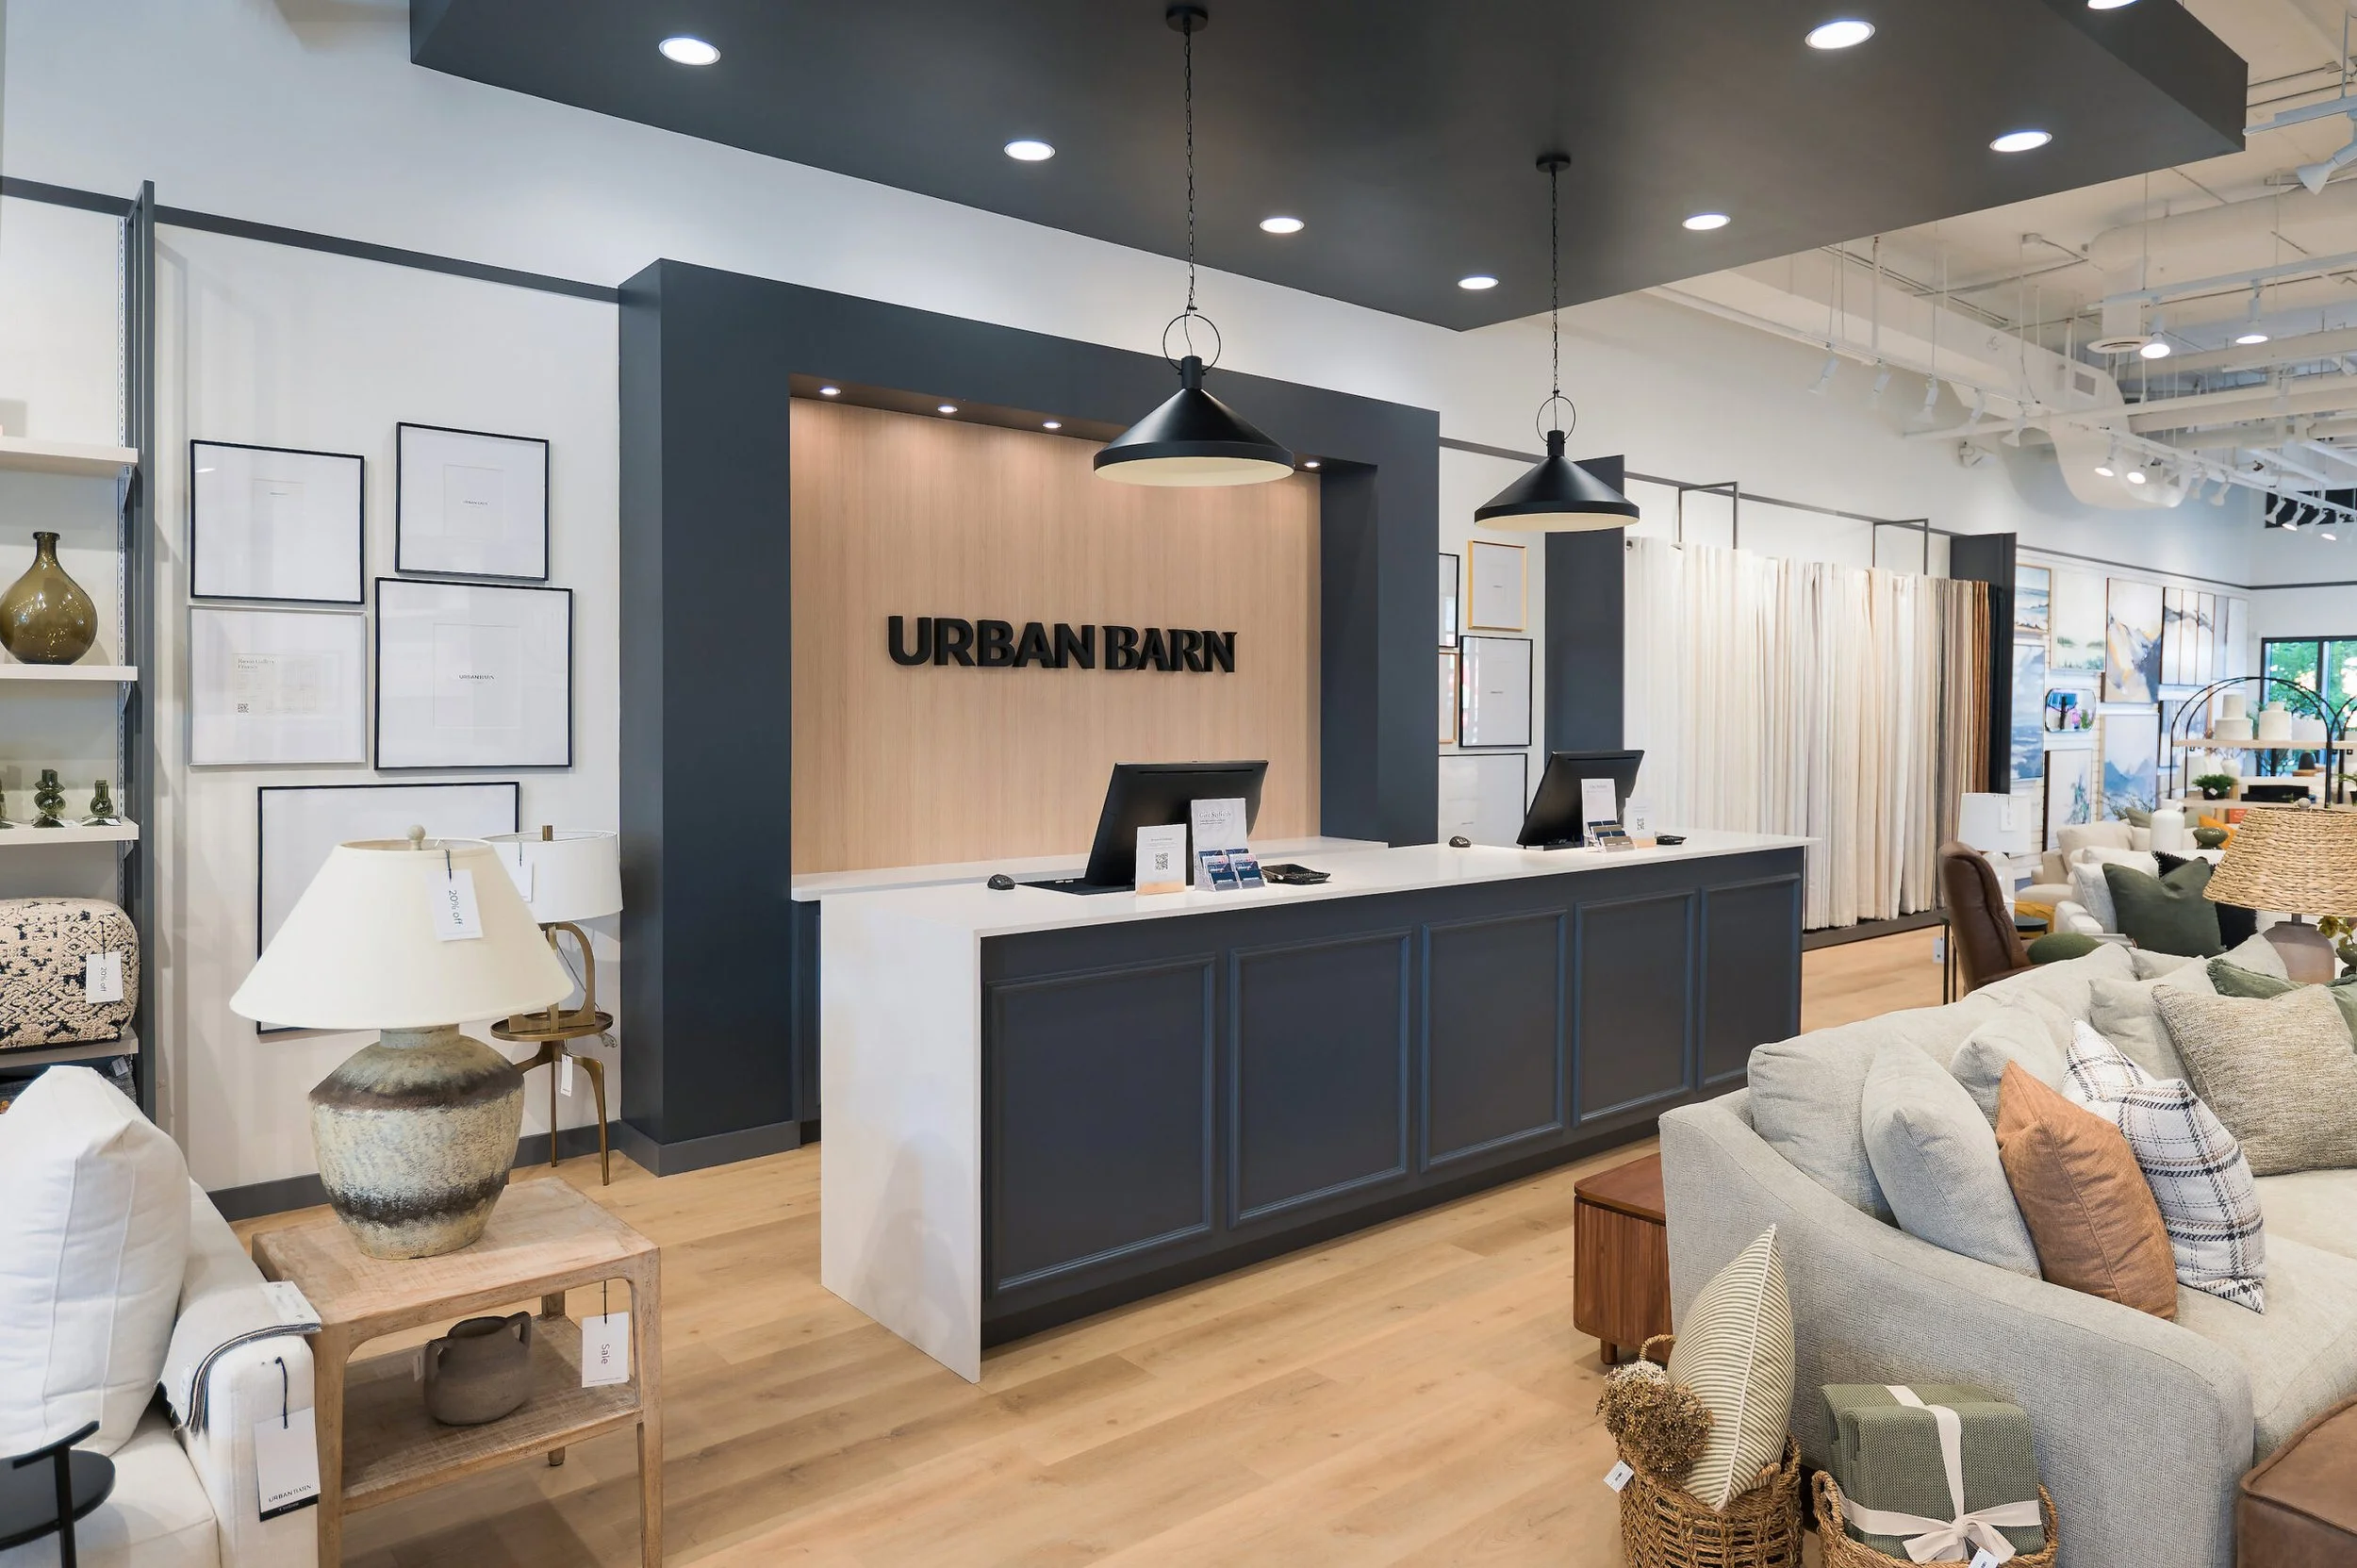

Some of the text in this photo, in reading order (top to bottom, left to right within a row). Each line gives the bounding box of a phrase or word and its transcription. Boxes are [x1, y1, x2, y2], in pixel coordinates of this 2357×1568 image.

[887, 615, 1238, 673] URBAN BARN
[448, 889, 463, 925] 20% off
[602, 1344, 610, 1364] Sale
[268, 1491, 292, 1502] URBAN
